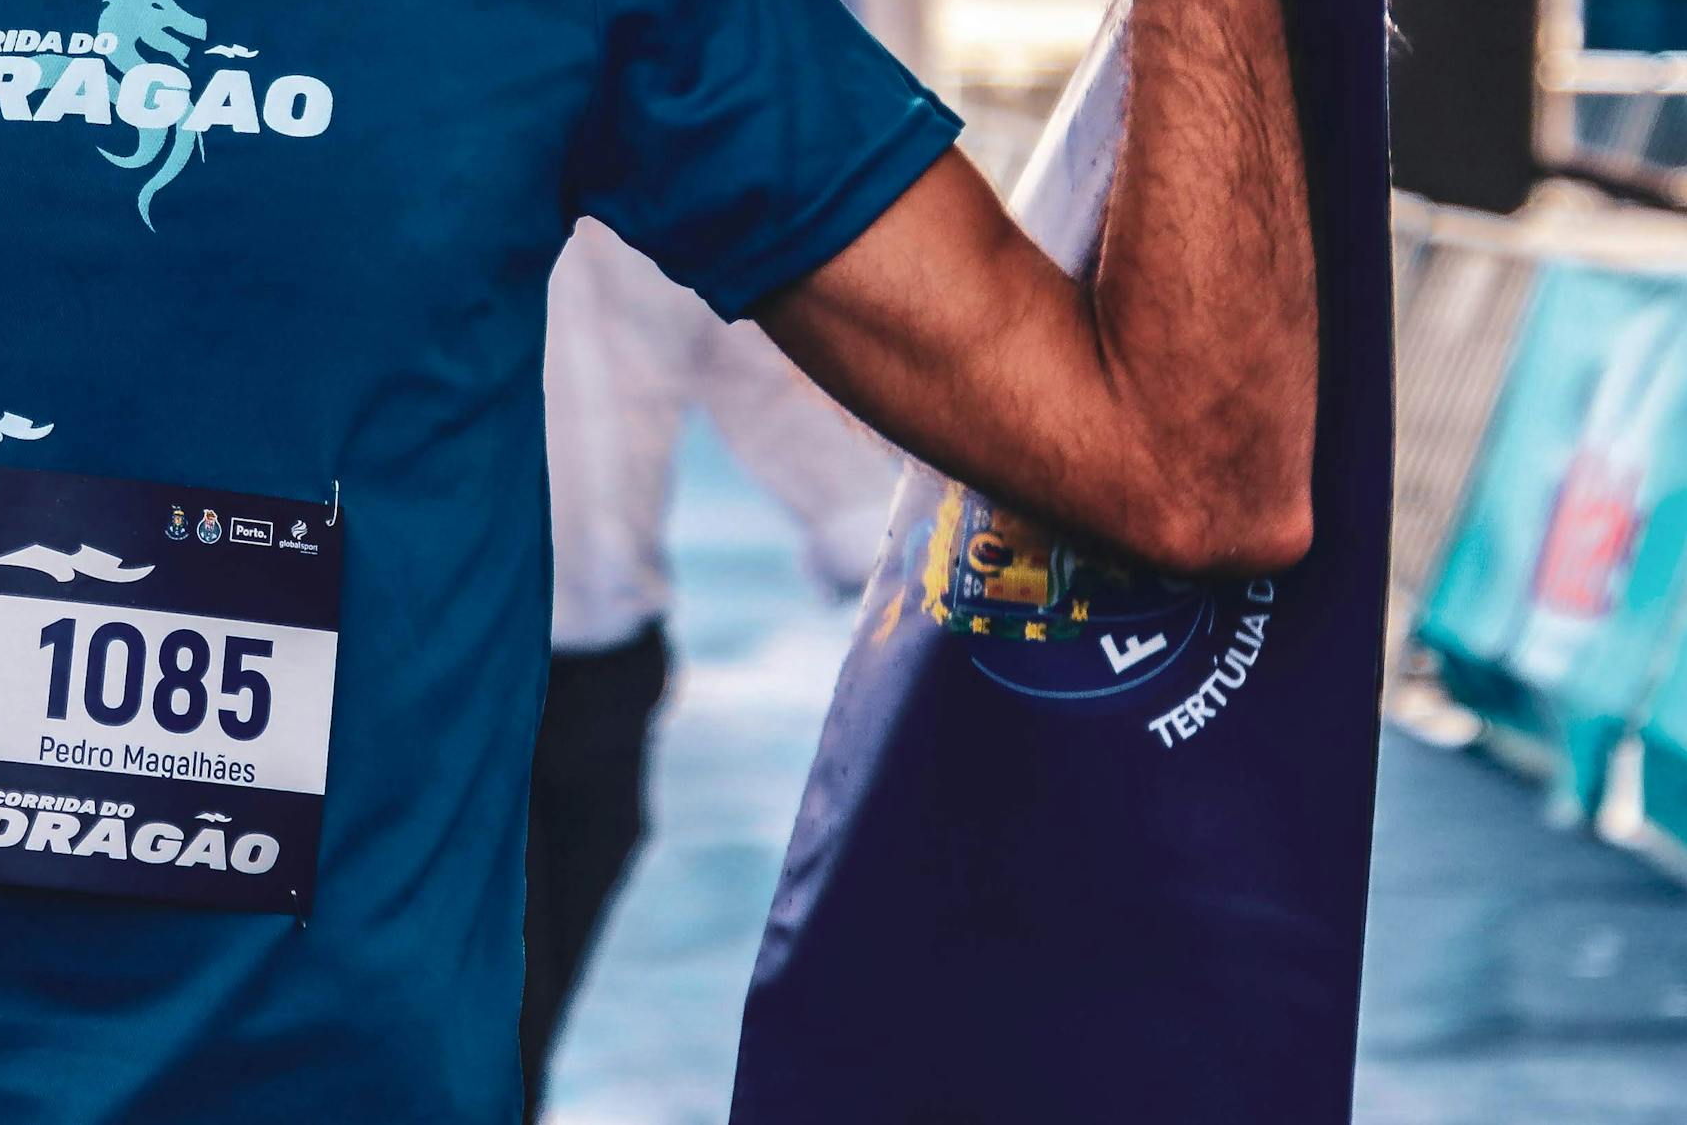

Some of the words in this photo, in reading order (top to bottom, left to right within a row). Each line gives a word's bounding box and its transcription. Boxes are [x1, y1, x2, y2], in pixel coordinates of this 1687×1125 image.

[67, 31, 119, 56] DO
[235, 524, 268, 540] Porto.
[1099, 632, 1168, 675] F
[39, 617, 275, 743] 1085
[1146, 613, 1271, 749] TERTÚLIA
[38, 735, 115, 769] Pedro
[122, 743, 257, 784] Magalhães
[99, 801, 137, 820] DO
